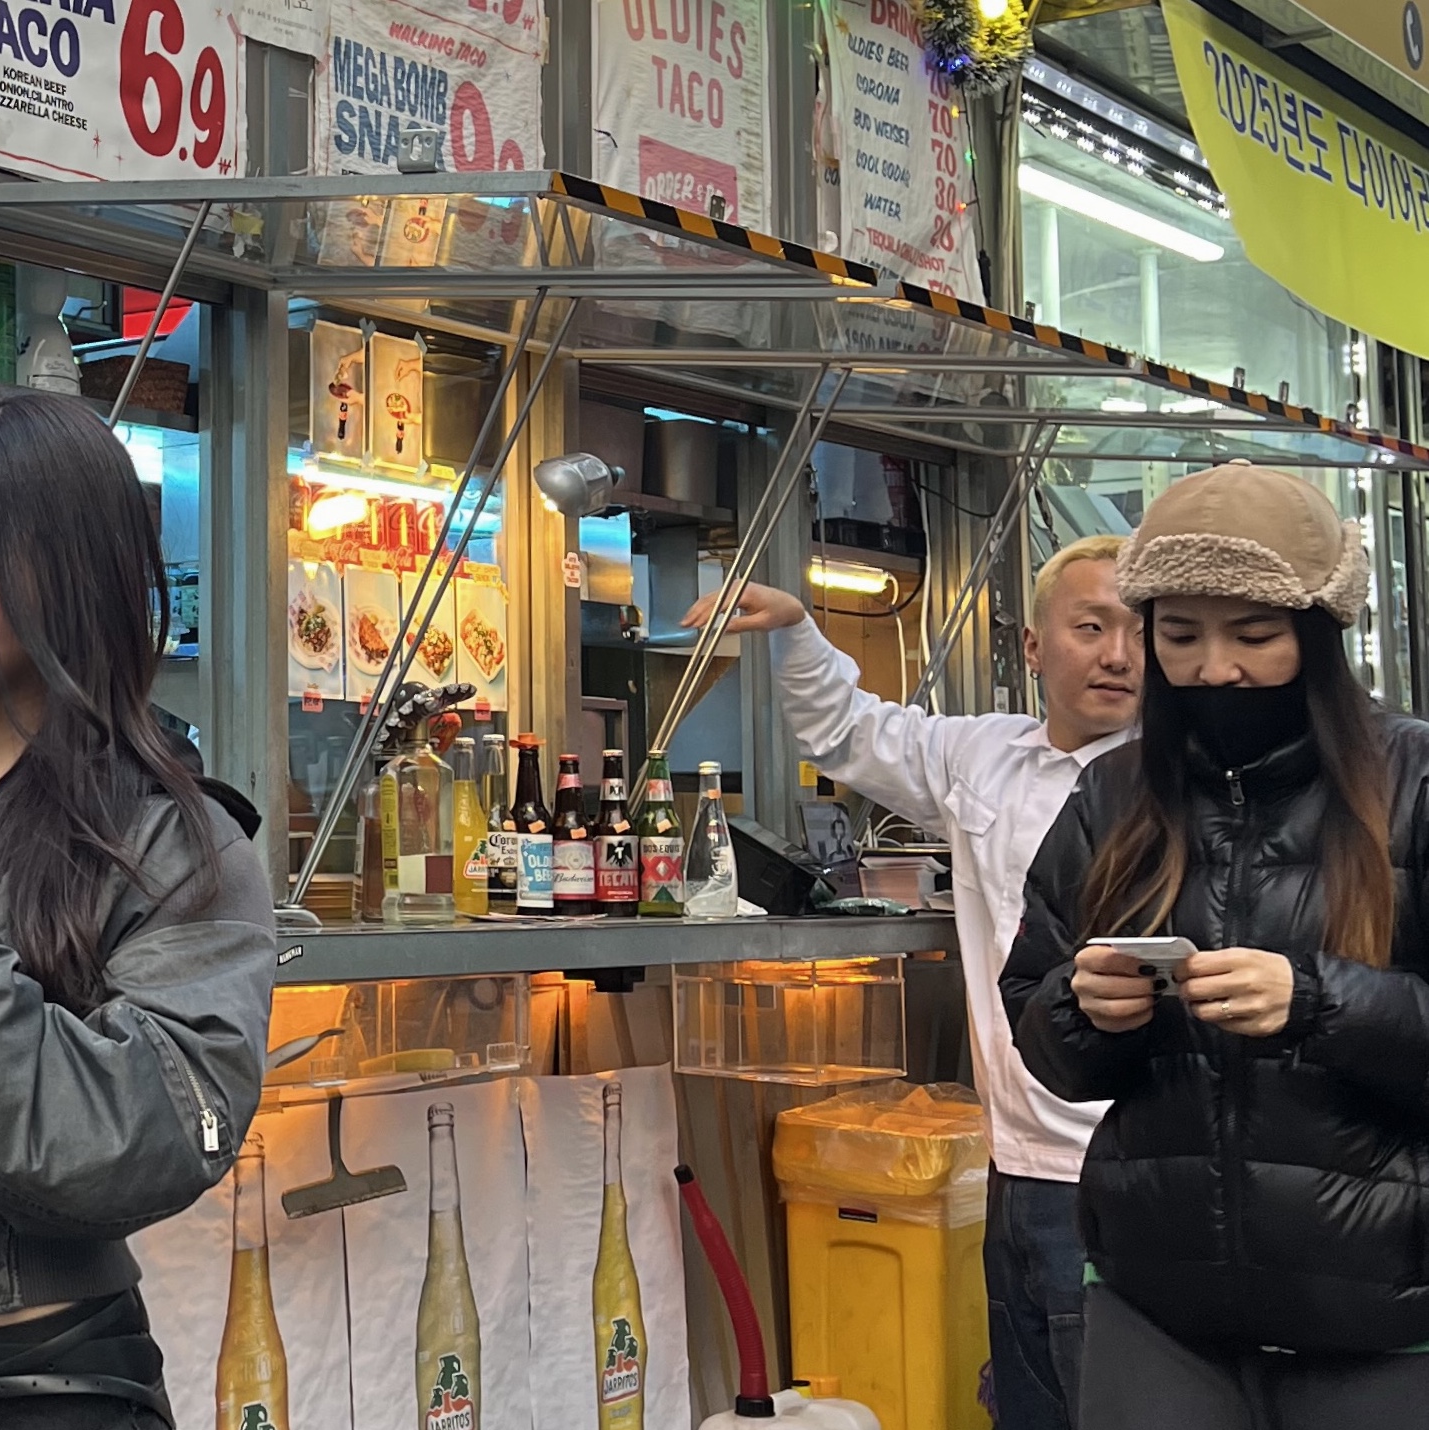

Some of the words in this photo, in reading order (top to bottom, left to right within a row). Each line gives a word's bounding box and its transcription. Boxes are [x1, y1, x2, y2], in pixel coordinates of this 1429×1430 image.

[388, 21, 454, 57] WALKING
[457, 40, 487, 68] TACO
[624, 0, 747, 80] OLDIES
[3, 65, 43, 90] KOREAN
[44, 77, 68, 97] BEEF
[119, 0, 227, 169] 6.9
[333, 36, 392, 105] MEGA
[393, 51, 448, 127] BOMB
[652, 55, 724, 129] TACO
[856, 72, 901, 106] CORONA
[51, 110, 88, 131] CHEESE
[333, 99, 448, 171] SNA
[1203, 40, 1333, 183] 2025년도
[864, 192, 902, 222] WATER
[603, 1372, 638, 1395] JARRITOS
